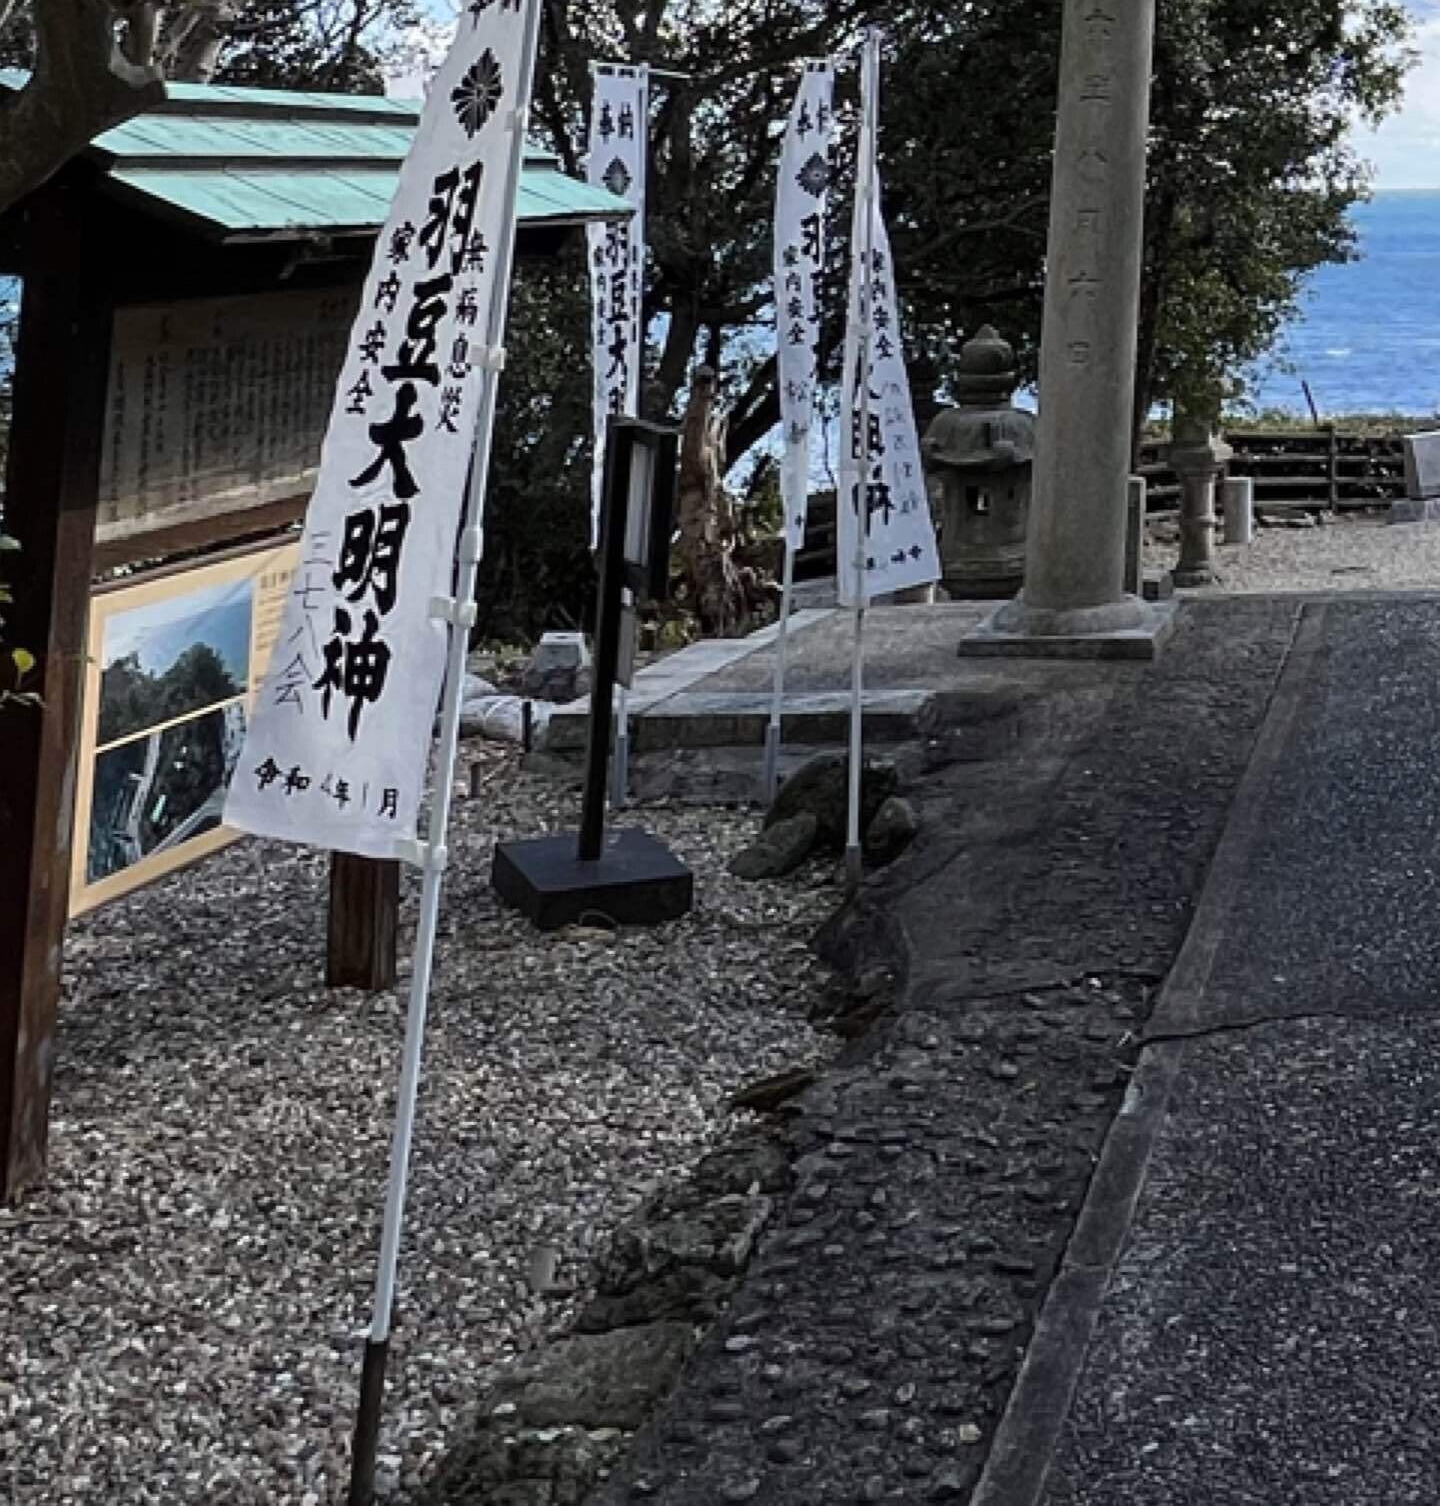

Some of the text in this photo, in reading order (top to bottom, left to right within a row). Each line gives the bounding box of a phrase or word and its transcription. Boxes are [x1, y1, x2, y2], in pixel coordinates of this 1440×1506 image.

[596, 98, 634, 143] 奉納
[345, 221, 415, 414] 家内安全
[436, 227, 489, 432] 無病息災
[783, 244, 806, 346] 家内安全
[312, 160, 483, 743] 羽豆大明神
[273, 531, 334, 714] 三七八会
